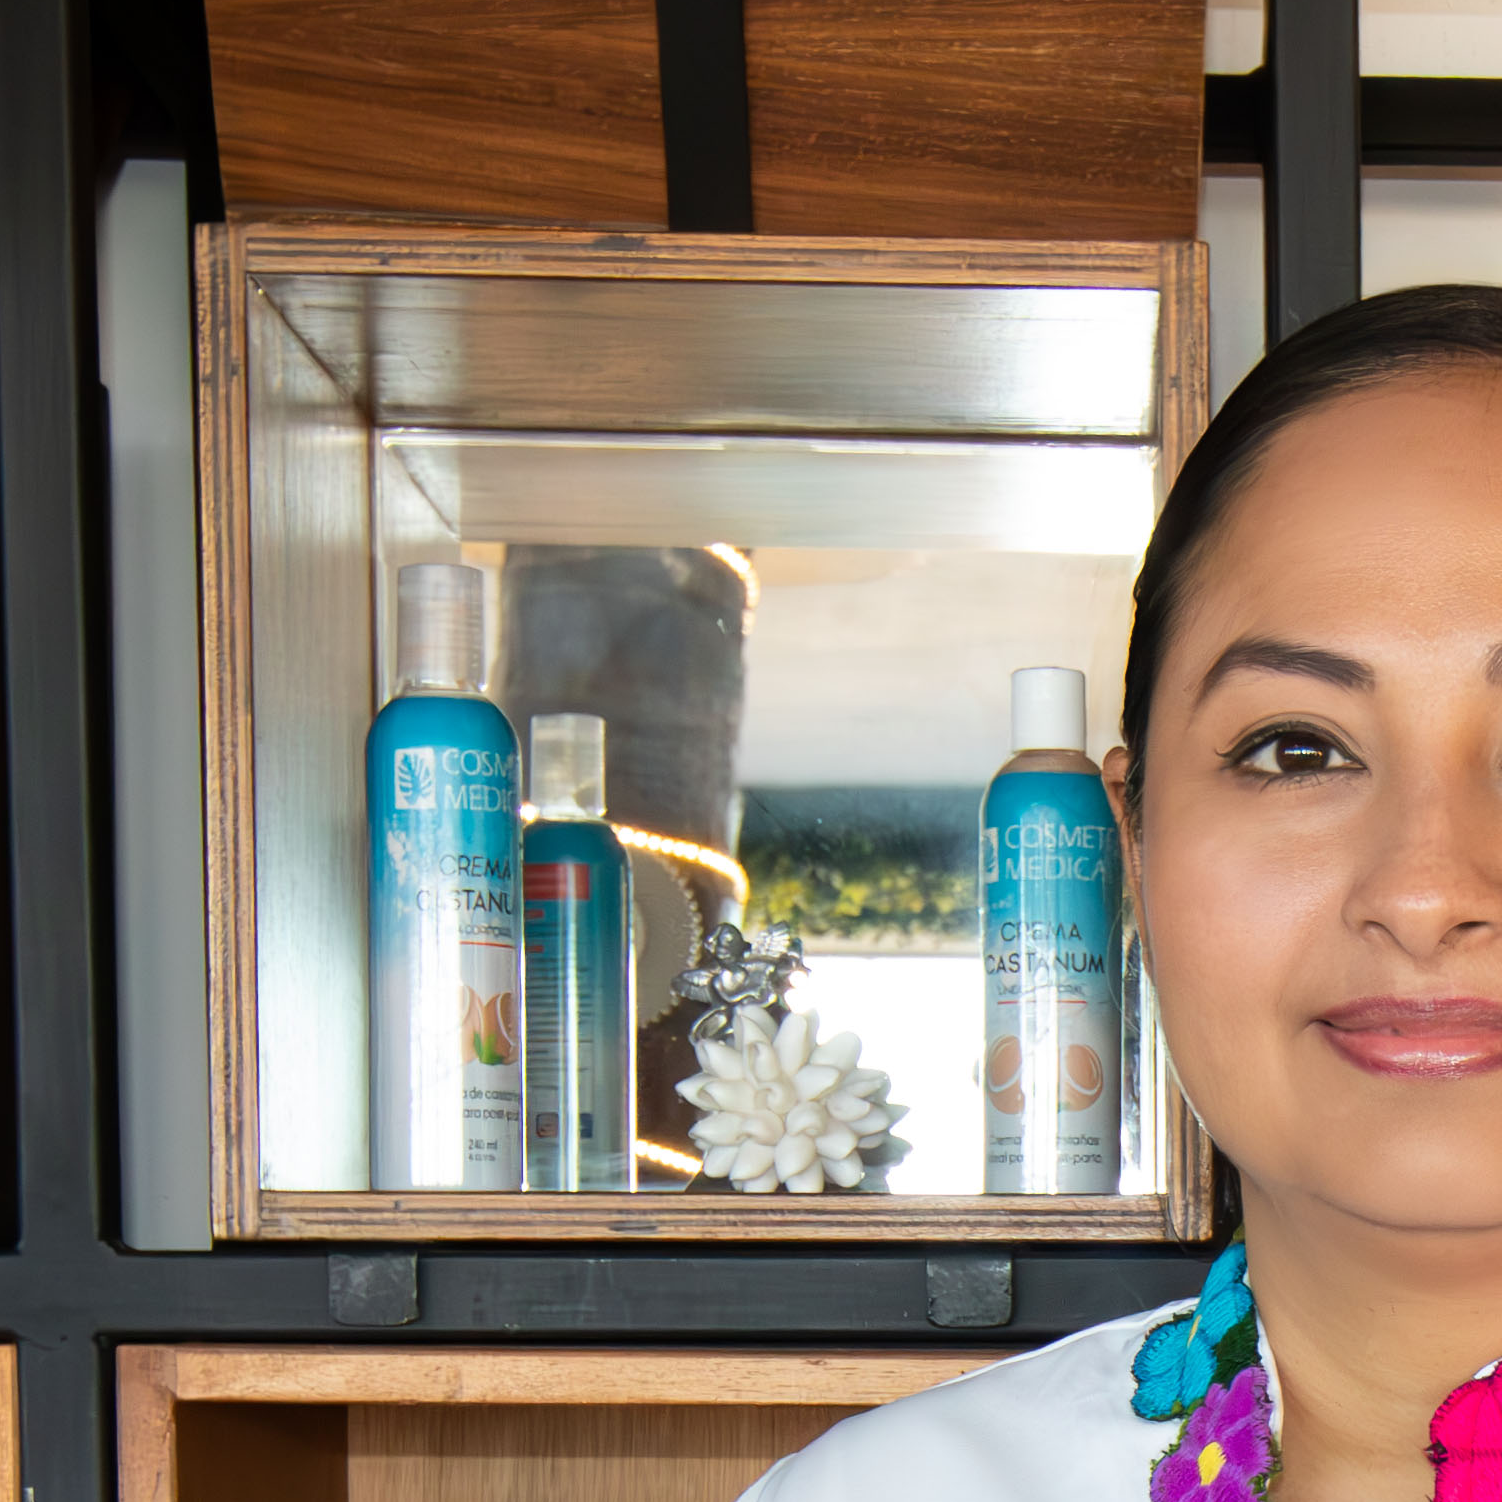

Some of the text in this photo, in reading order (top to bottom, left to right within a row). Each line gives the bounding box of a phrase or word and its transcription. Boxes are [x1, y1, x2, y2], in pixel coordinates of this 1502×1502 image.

[442, 748, 516, 778] COSM
[445, 784, 518, 815] MEDIC
[1004, 823, 1109, 851] COSMET
[439, 855, 511, 879] CREMA
[1005, 855, 1106, 882] MEDICA
[1001, 921, 1083, 942] CREMA
[985, 952, 1106, 975] CASTANUM
